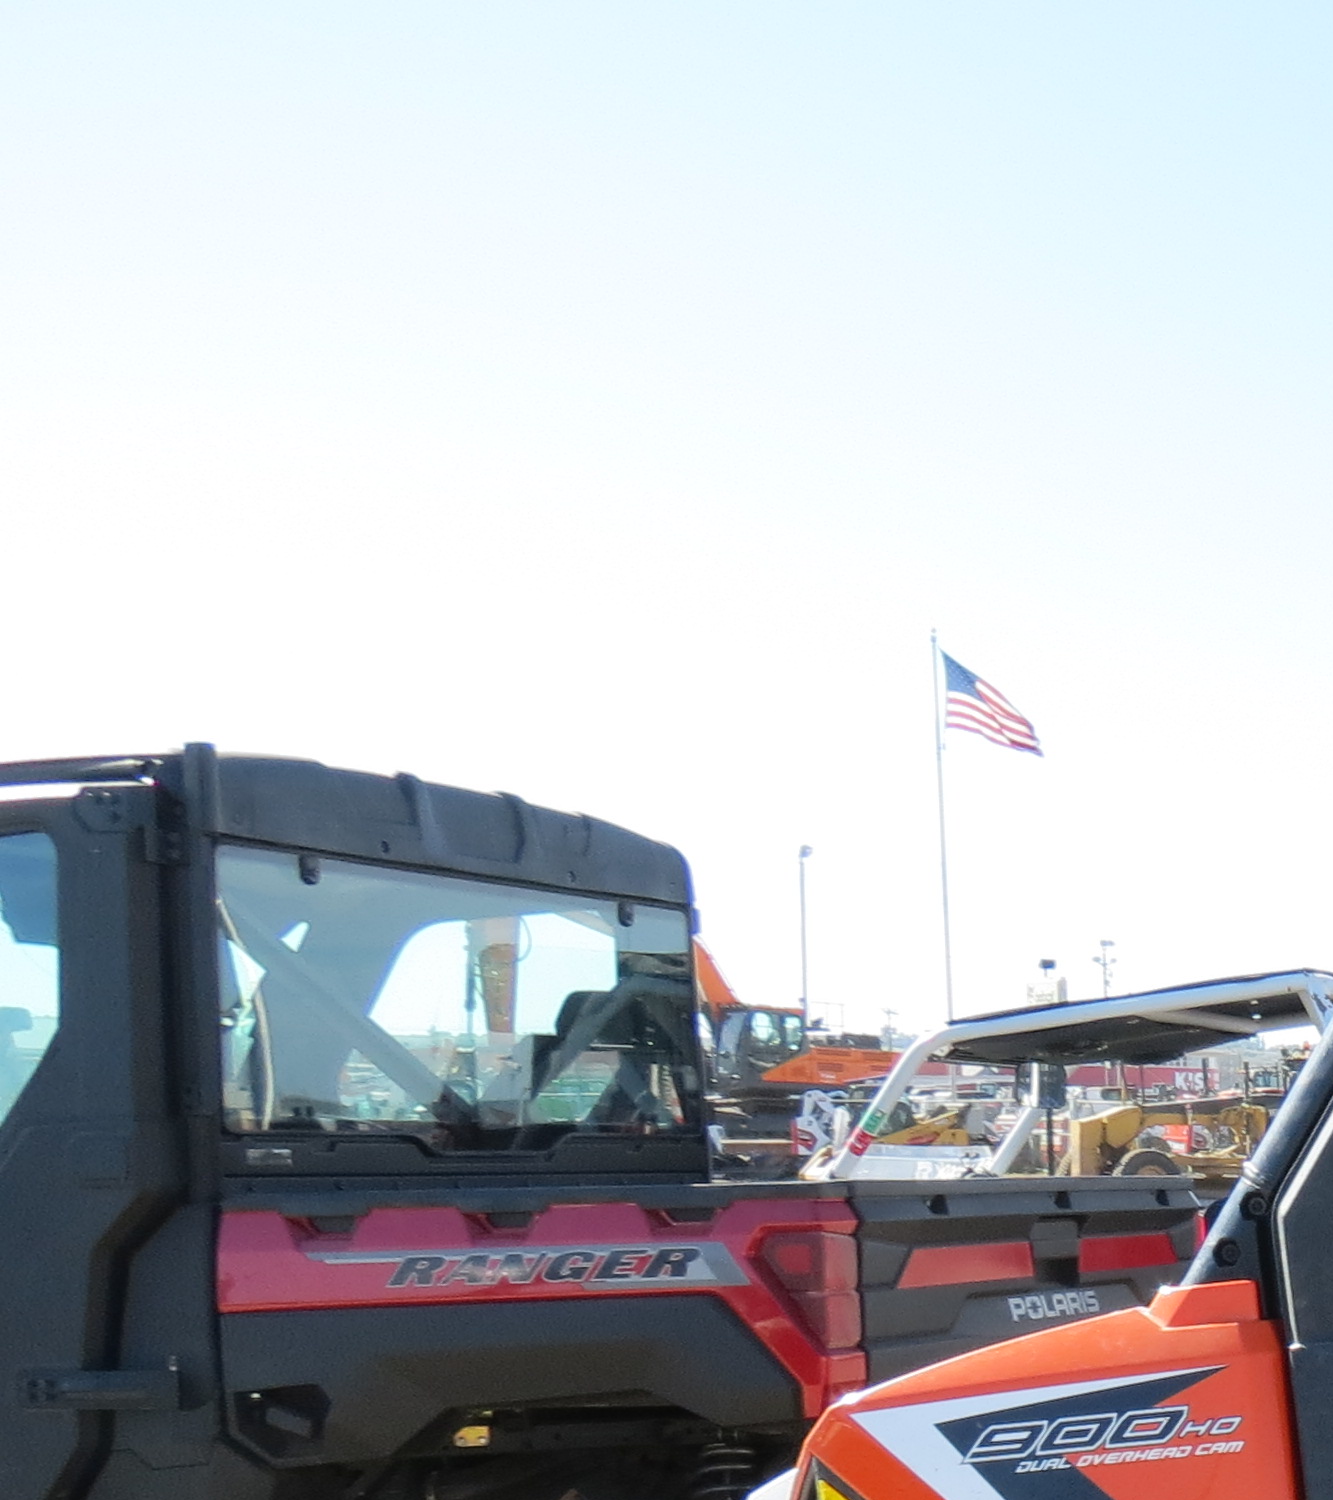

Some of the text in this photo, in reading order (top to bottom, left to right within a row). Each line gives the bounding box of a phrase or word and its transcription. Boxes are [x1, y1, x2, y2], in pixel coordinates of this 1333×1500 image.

[386, 1247, 702, 1289] RANGER
[1007, 1290, 1100, 1322] POLARIS
[963, 1405, 1242, 1465] 900 HO
[1015, 1440, 1245, 1475] DUAL OVERHEAD CAM
